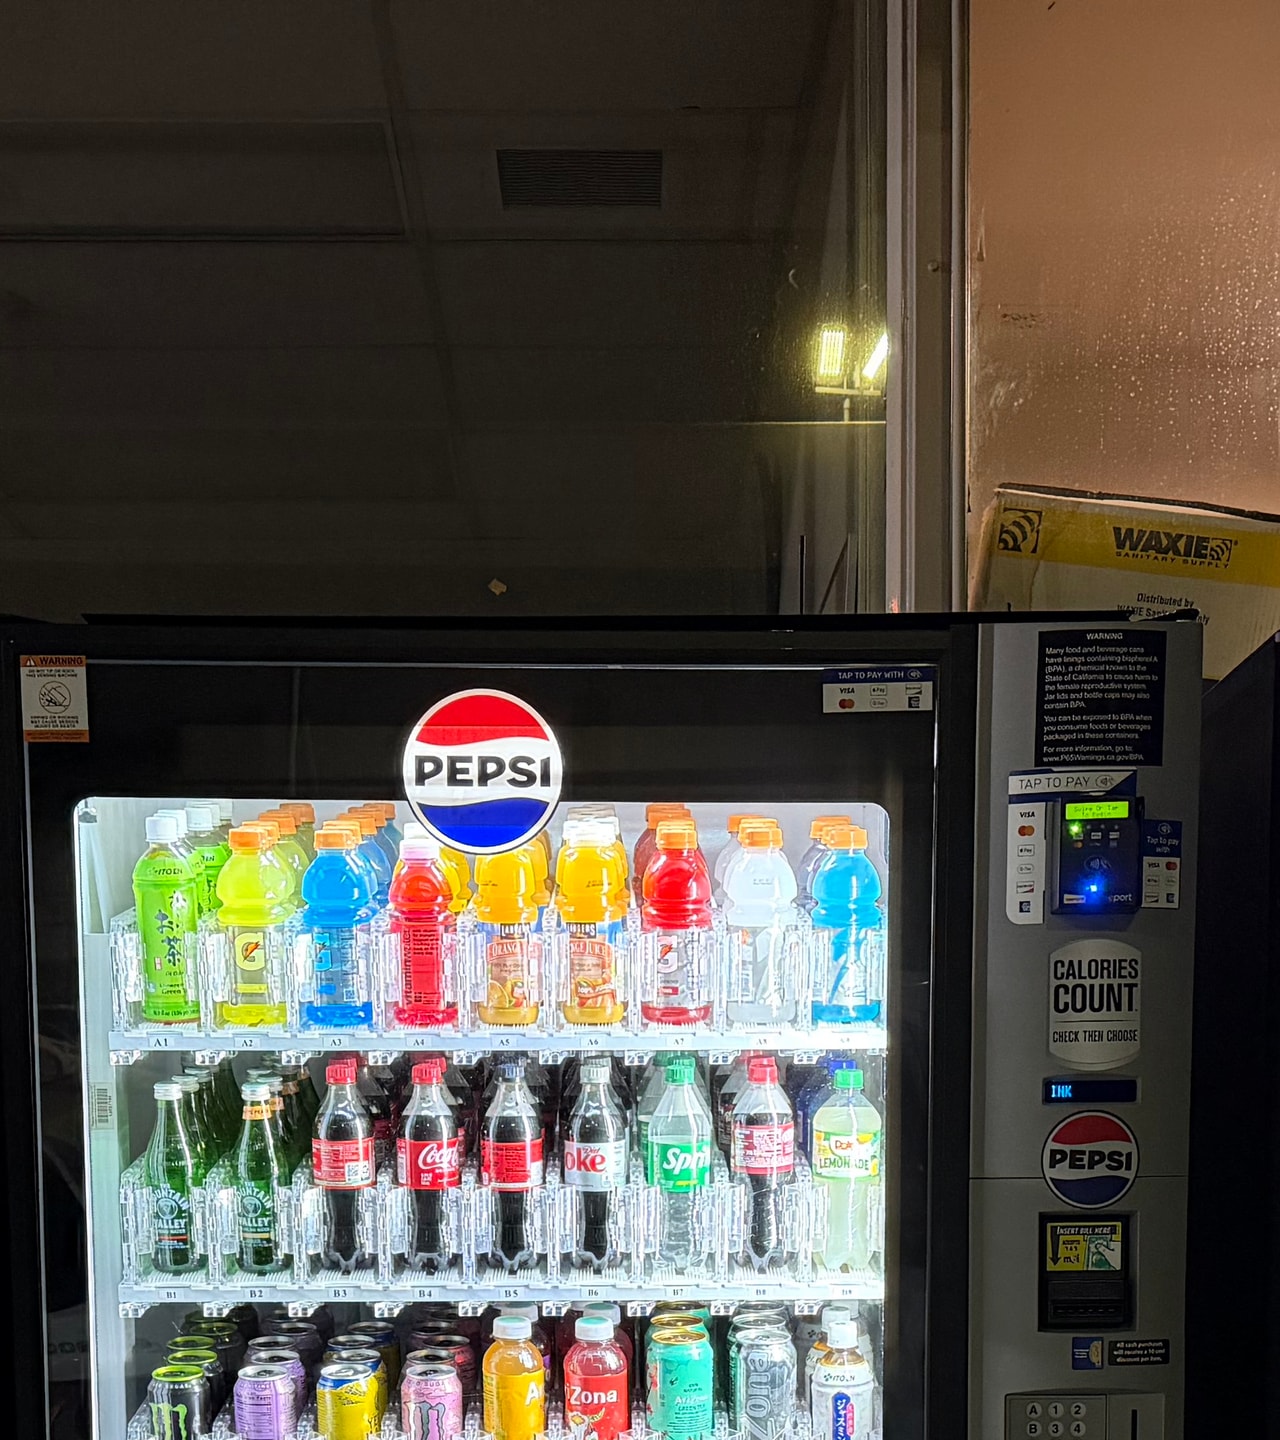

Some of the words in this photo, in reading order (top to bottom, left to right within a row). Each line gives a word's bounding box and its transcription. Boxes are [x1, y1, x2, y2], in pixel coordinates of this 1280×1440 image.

[1113, 526, 1210, 560] WAXIE
[1116, 551, 1175, 564] SANITARY
[1182, 559, 1230, 569] SUPPLY
[1137, 593, 1182, 608] Distributed
[1184, 600, 1195, 609] by
[40, 657, 83, 665] WARNING
[414, 755, 553, 789] PEPSI
[1019, 779, 1043, 790] TAP
[1046, 778, 1062, 788] TO
[1066, 777, 1090, 787] PAY
[1053, 958, 1139, 980] CALORIES
[154, 1037, 168, 1047] A1
[242, 1039, 253, 1047] A2
[331, 1039, 342, 1047] A3
[1053, 1030, 1080, 1043] CHECK
[1083, 1030, 1104, 1042] THEN
[1106, 1029, 1138, 1042] CHOOSE
[1049, 1149, 1132, 1171] PEPSI
[1056, 1226, 1079, 1235] INSERT
[166, 1290, 177, 1298] B1
[250, 1289, 263, 1298] B2
[333, 1289, 347, 1298] B3
